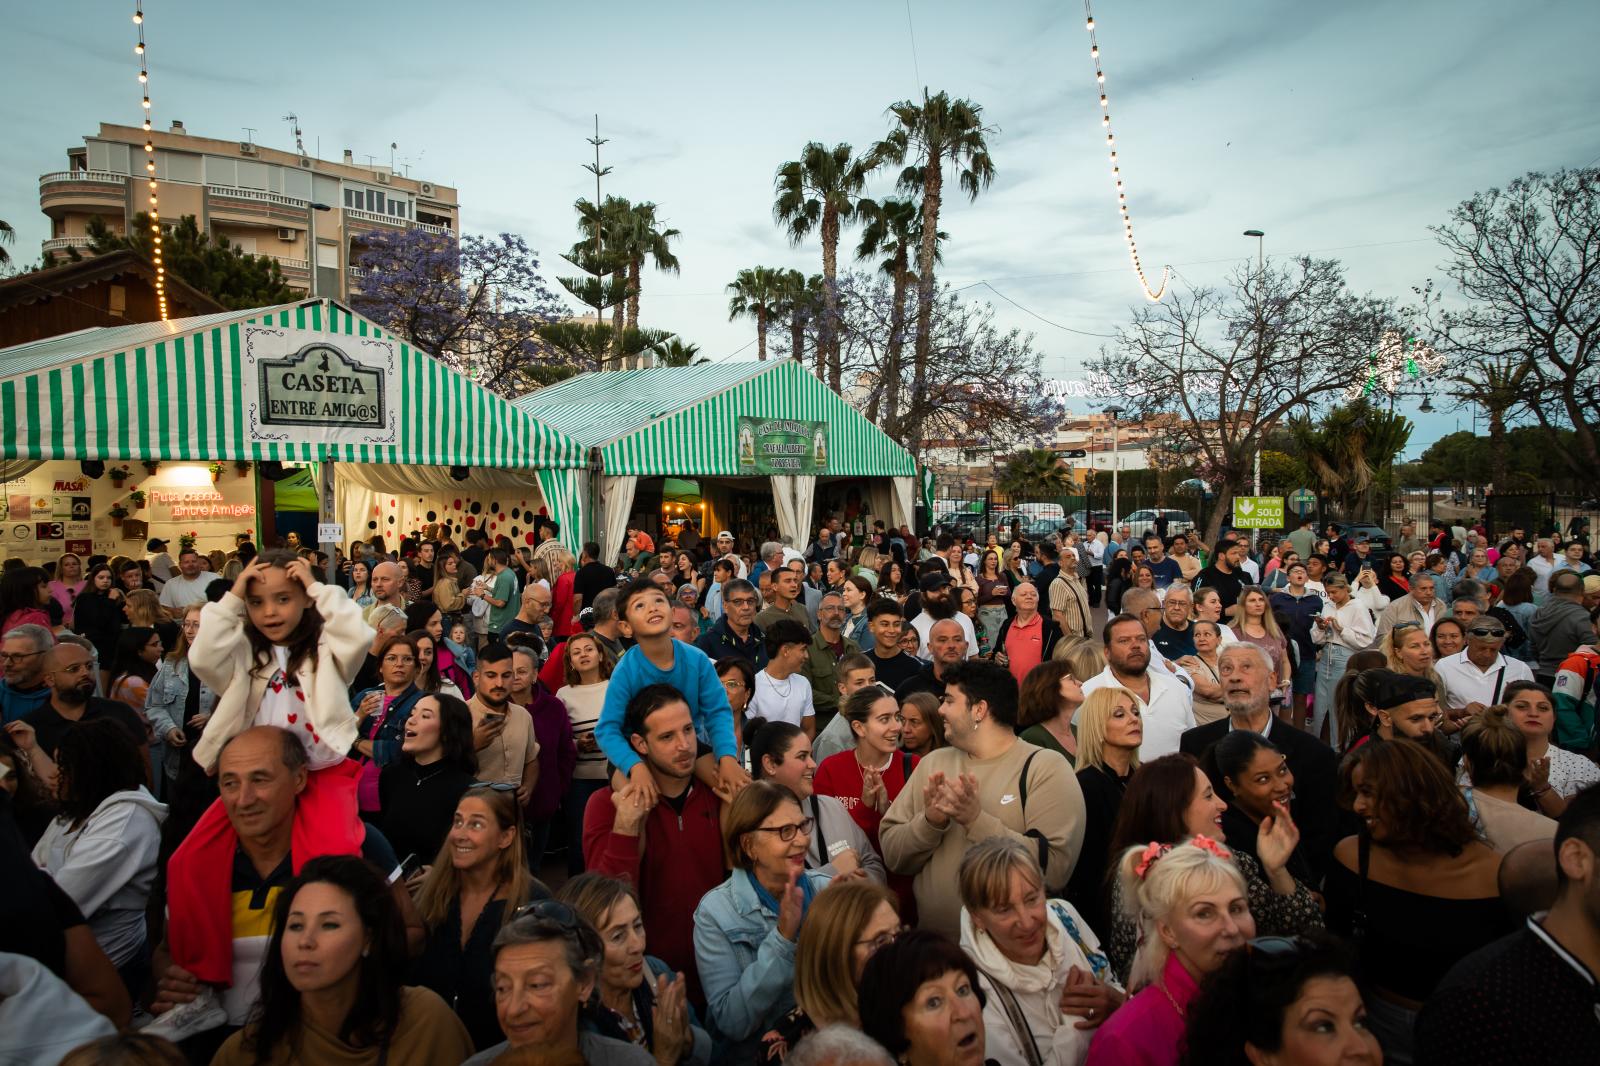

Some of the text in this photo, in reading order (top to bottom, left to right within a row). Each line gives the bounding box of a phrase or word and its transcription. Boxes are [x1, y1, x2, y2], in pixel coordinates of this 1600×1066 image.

[281, 372, 366, 394] CASETA
[271, 400, 378, 421] ENTRE AMIG@S
[53, 480, 84, 492] MASA
[173, 504, 256, 517] Entre Amig@s
[1257, 508, 1282, 517] SOLO
[1237, 518, 1282, 527] ENTRADA
